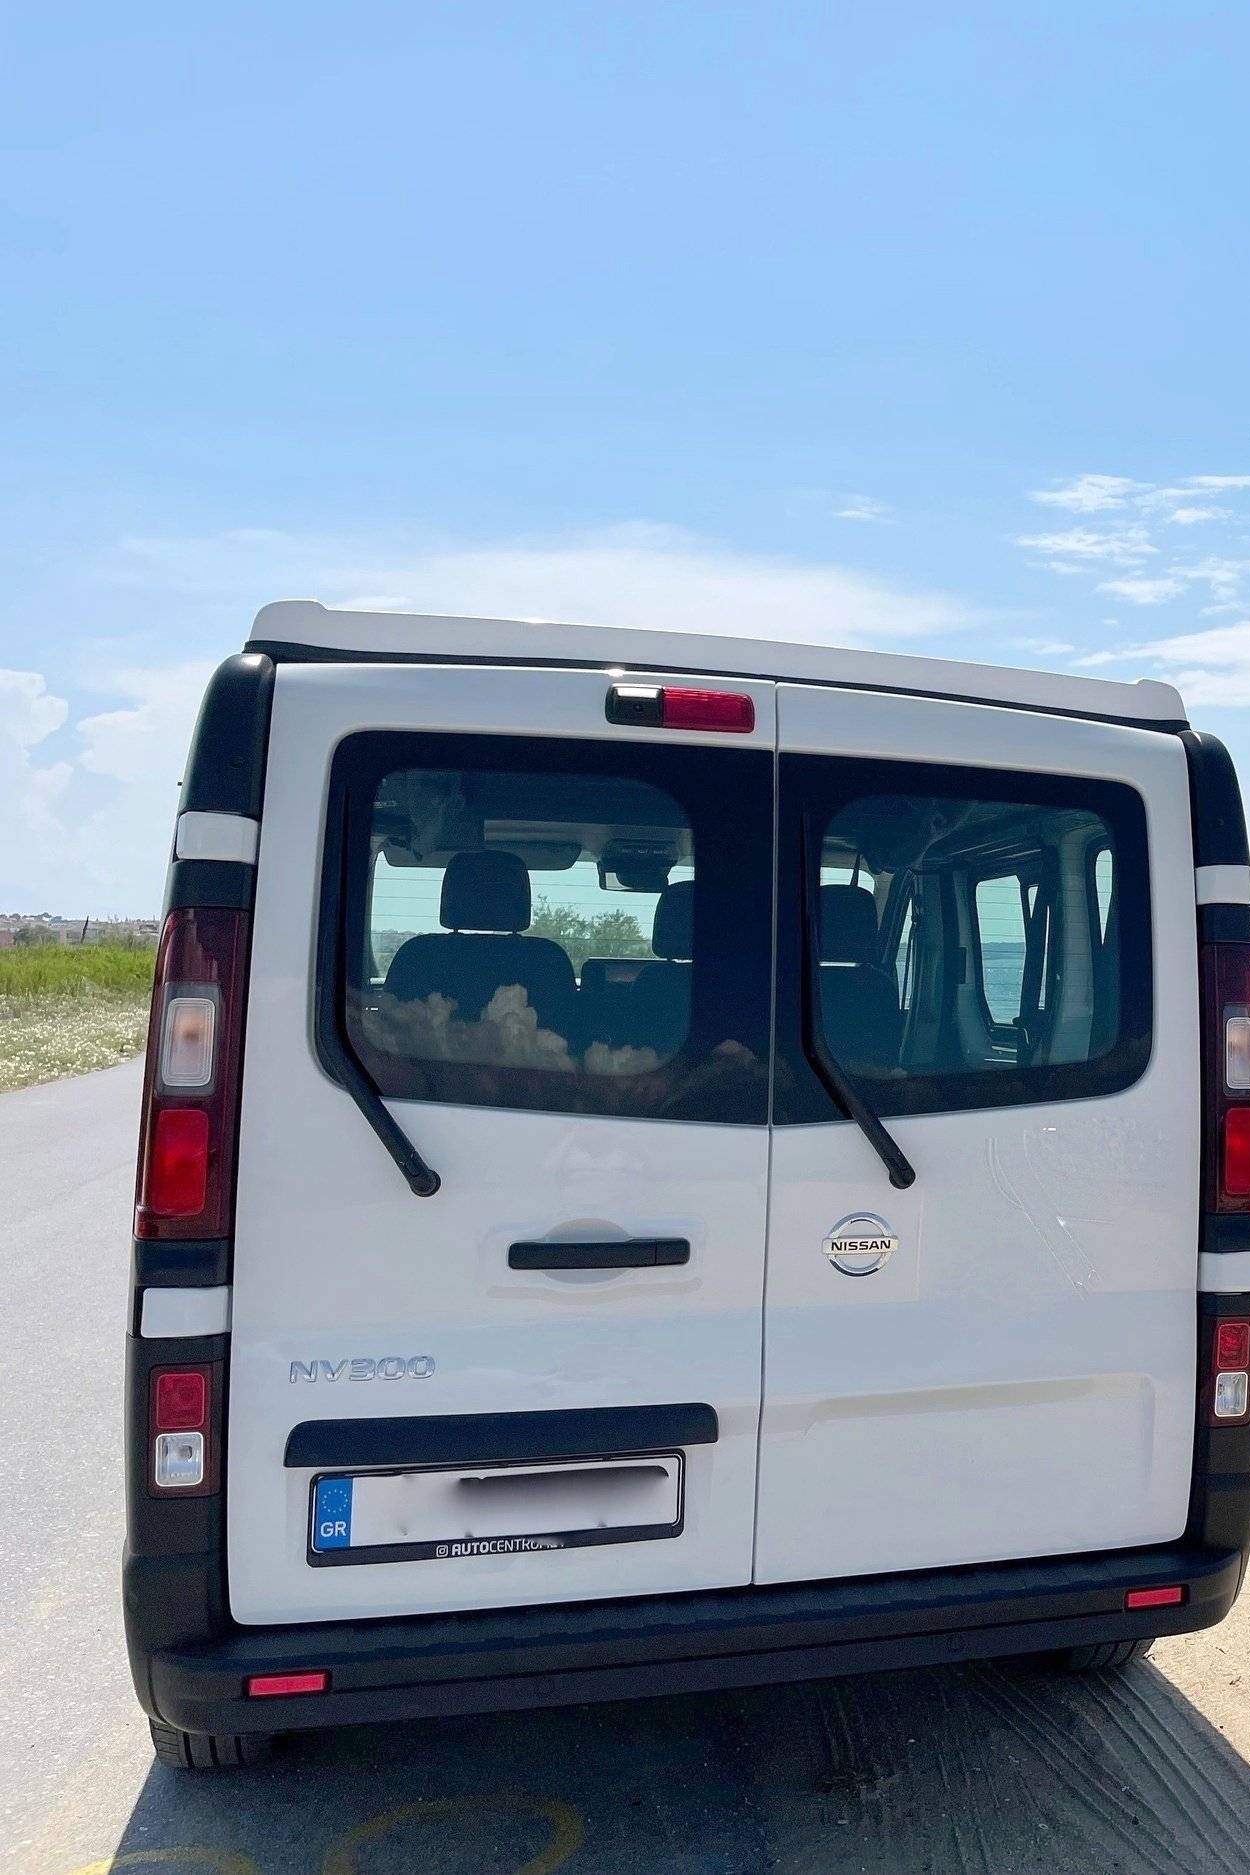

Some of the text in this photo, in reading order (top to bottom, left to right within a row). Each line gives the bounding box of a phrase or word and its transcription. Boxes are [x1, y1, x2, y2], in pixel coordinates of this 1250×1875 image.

[831, 1239, 891, 1251] NISSAN
[289, 1355, 436, 1384] NV300
[320, 1521, 347, 1537] GR
